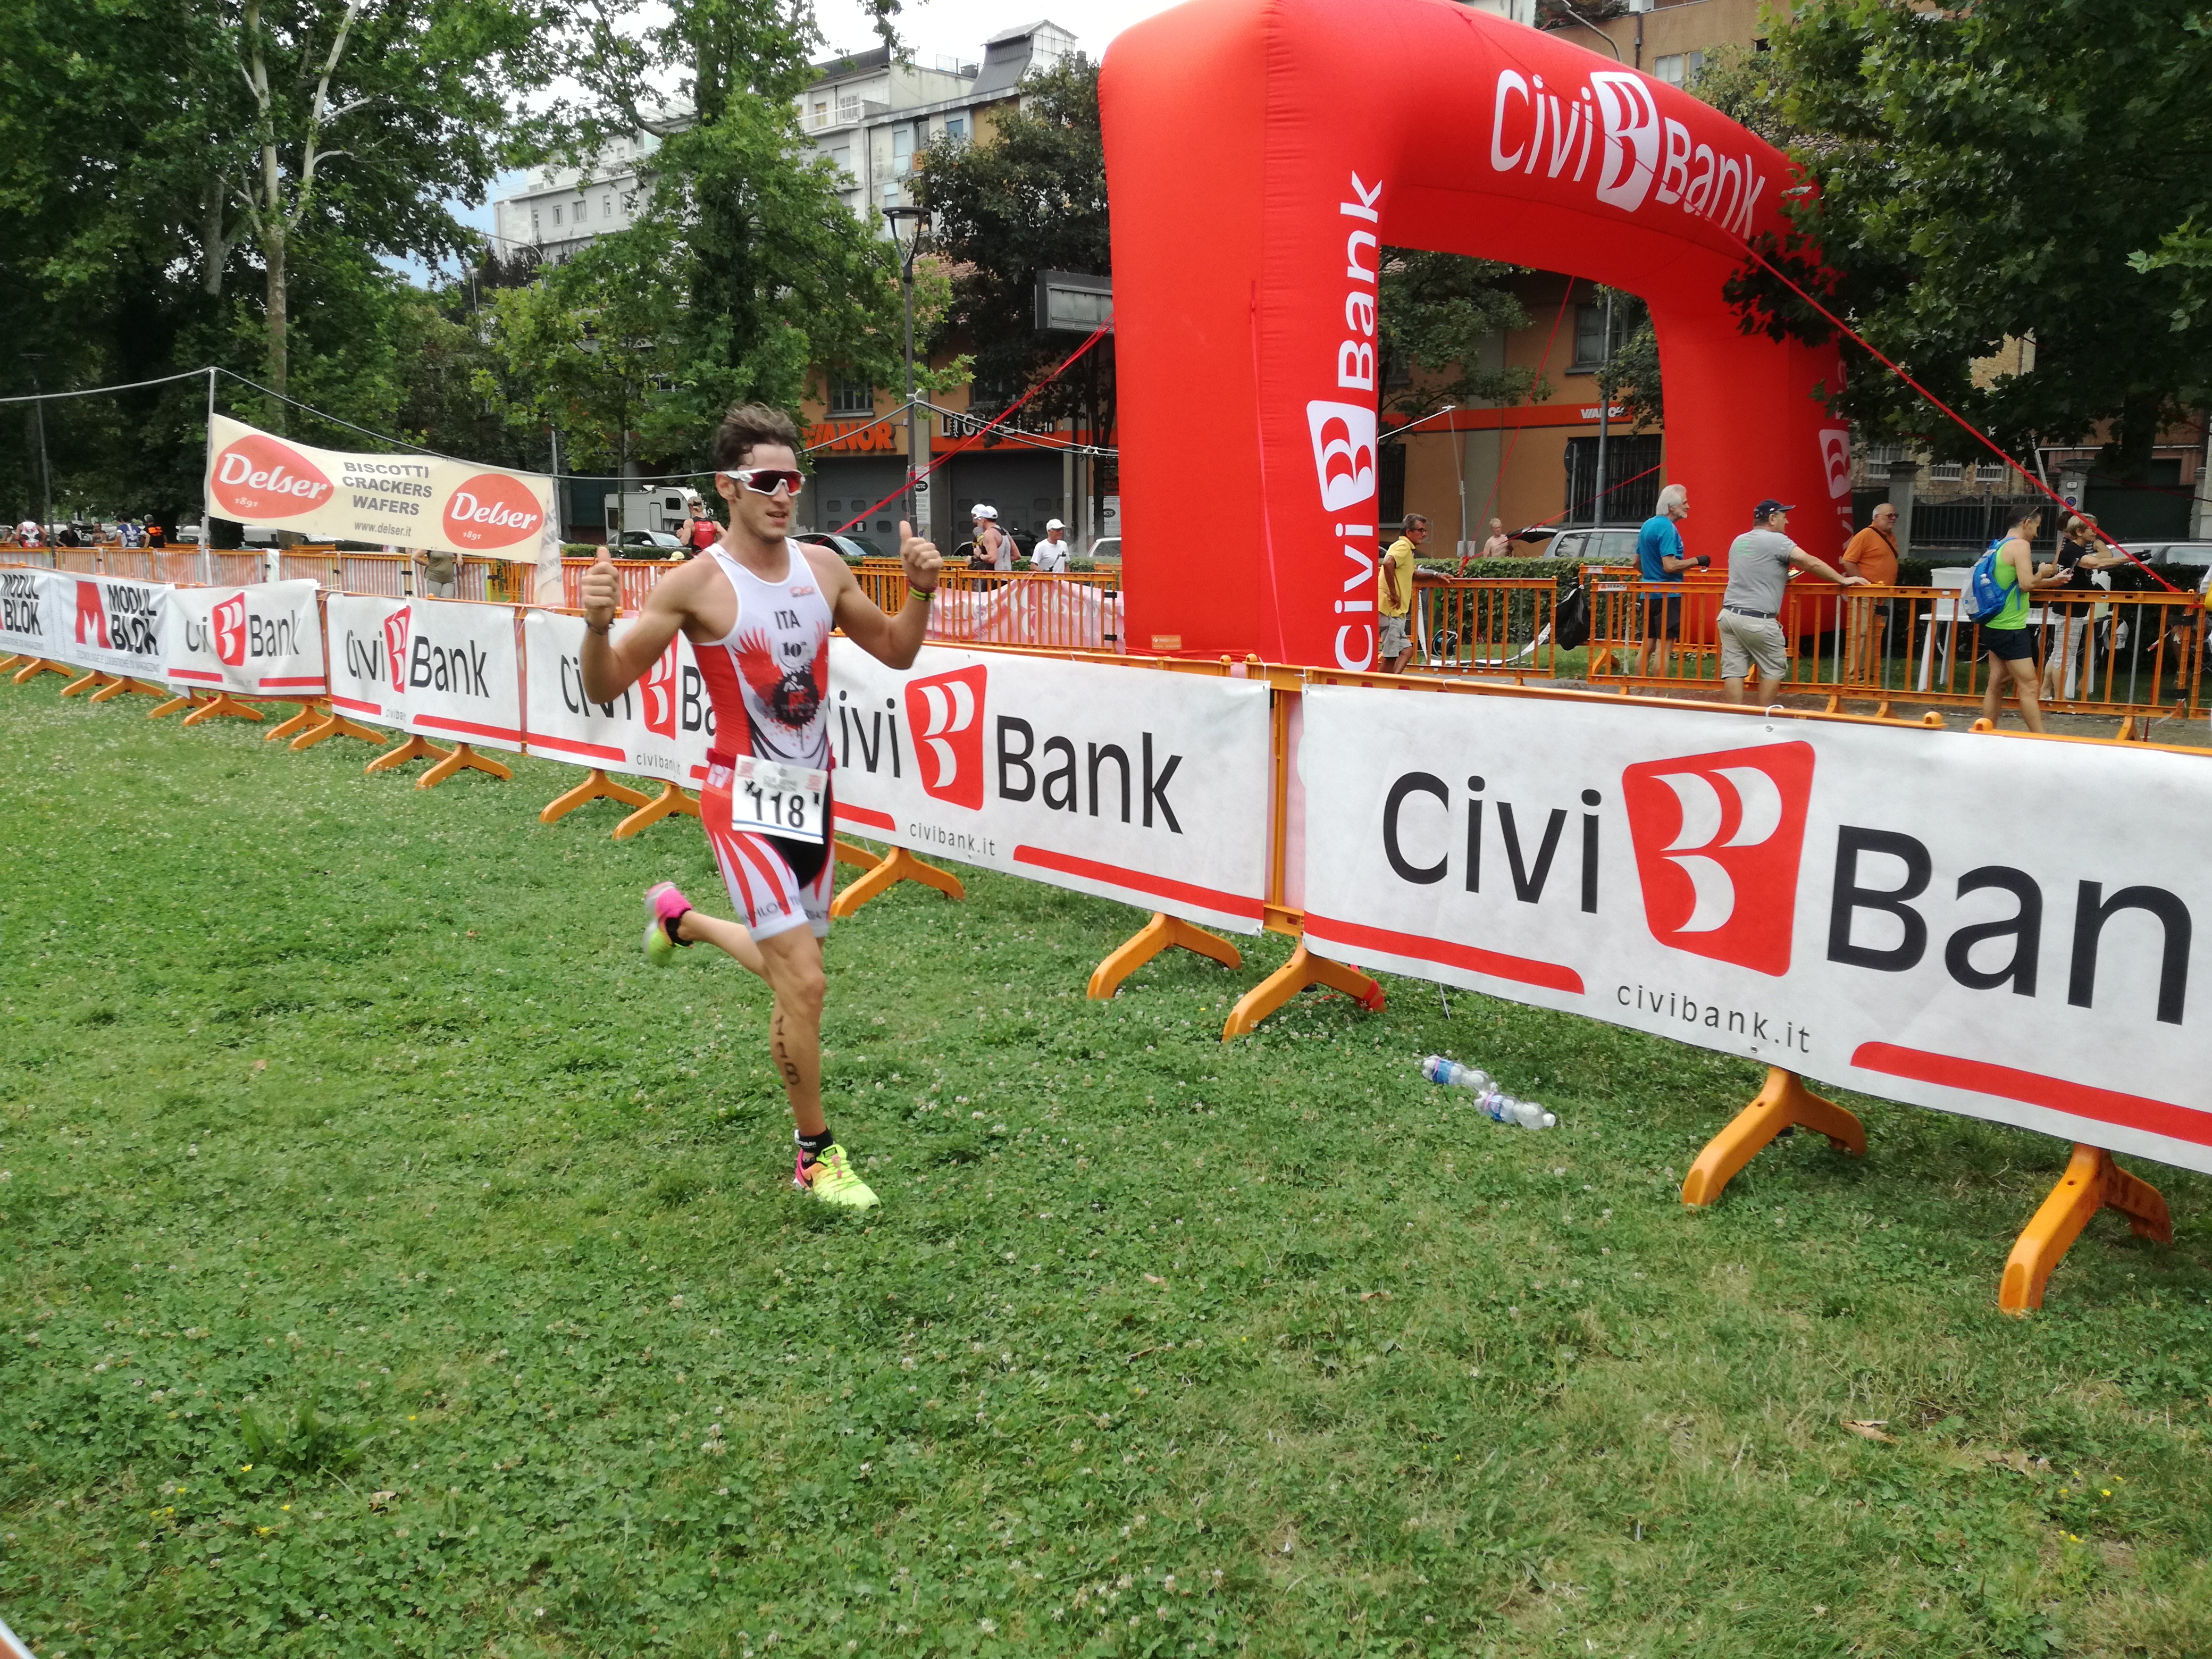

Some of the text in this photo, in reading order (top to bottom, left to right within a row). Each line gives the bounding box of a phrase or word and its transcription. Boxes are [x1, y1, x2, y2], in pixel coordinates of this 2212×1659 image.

[1490, 69, 1766, 240] Civi Bank
[1334, 170, 1382, 672] Civi Bank
[1580, 406, 1624, 419] VIAO
[219, 453, 328, 499] Delser
[342, 476, 433, 498] CRACKERS
[343, 462, 429, 479] BISCOTTI
[234, 497, 259, 508] 1891
[353, 495, 420, 516] WAFERS
[451, 492, 538, 530] Delser
[354, 522, 411, 537] www.delser.it
[462, 530, 482, 541] 1891
[3, 598, 43, 636] BLOK
[107, 584, 157, 616] MODUL
[111, 614, 159, 656] BLOK
[249, 609, 301, 657] Bank
[774, 609, 802, 630] ITA
[409, 635, 490, 698] Bank
[830, 690, 1184, 834] ivi Bank
[751, 788, 805, 829] 118
[909, 822, 996, 856] civibank.it
[1382, 771, 1602, 914] Civi
[1616, 985, 1811, 1053] civibank.it
[774, 1015, 801, 1086] 118
